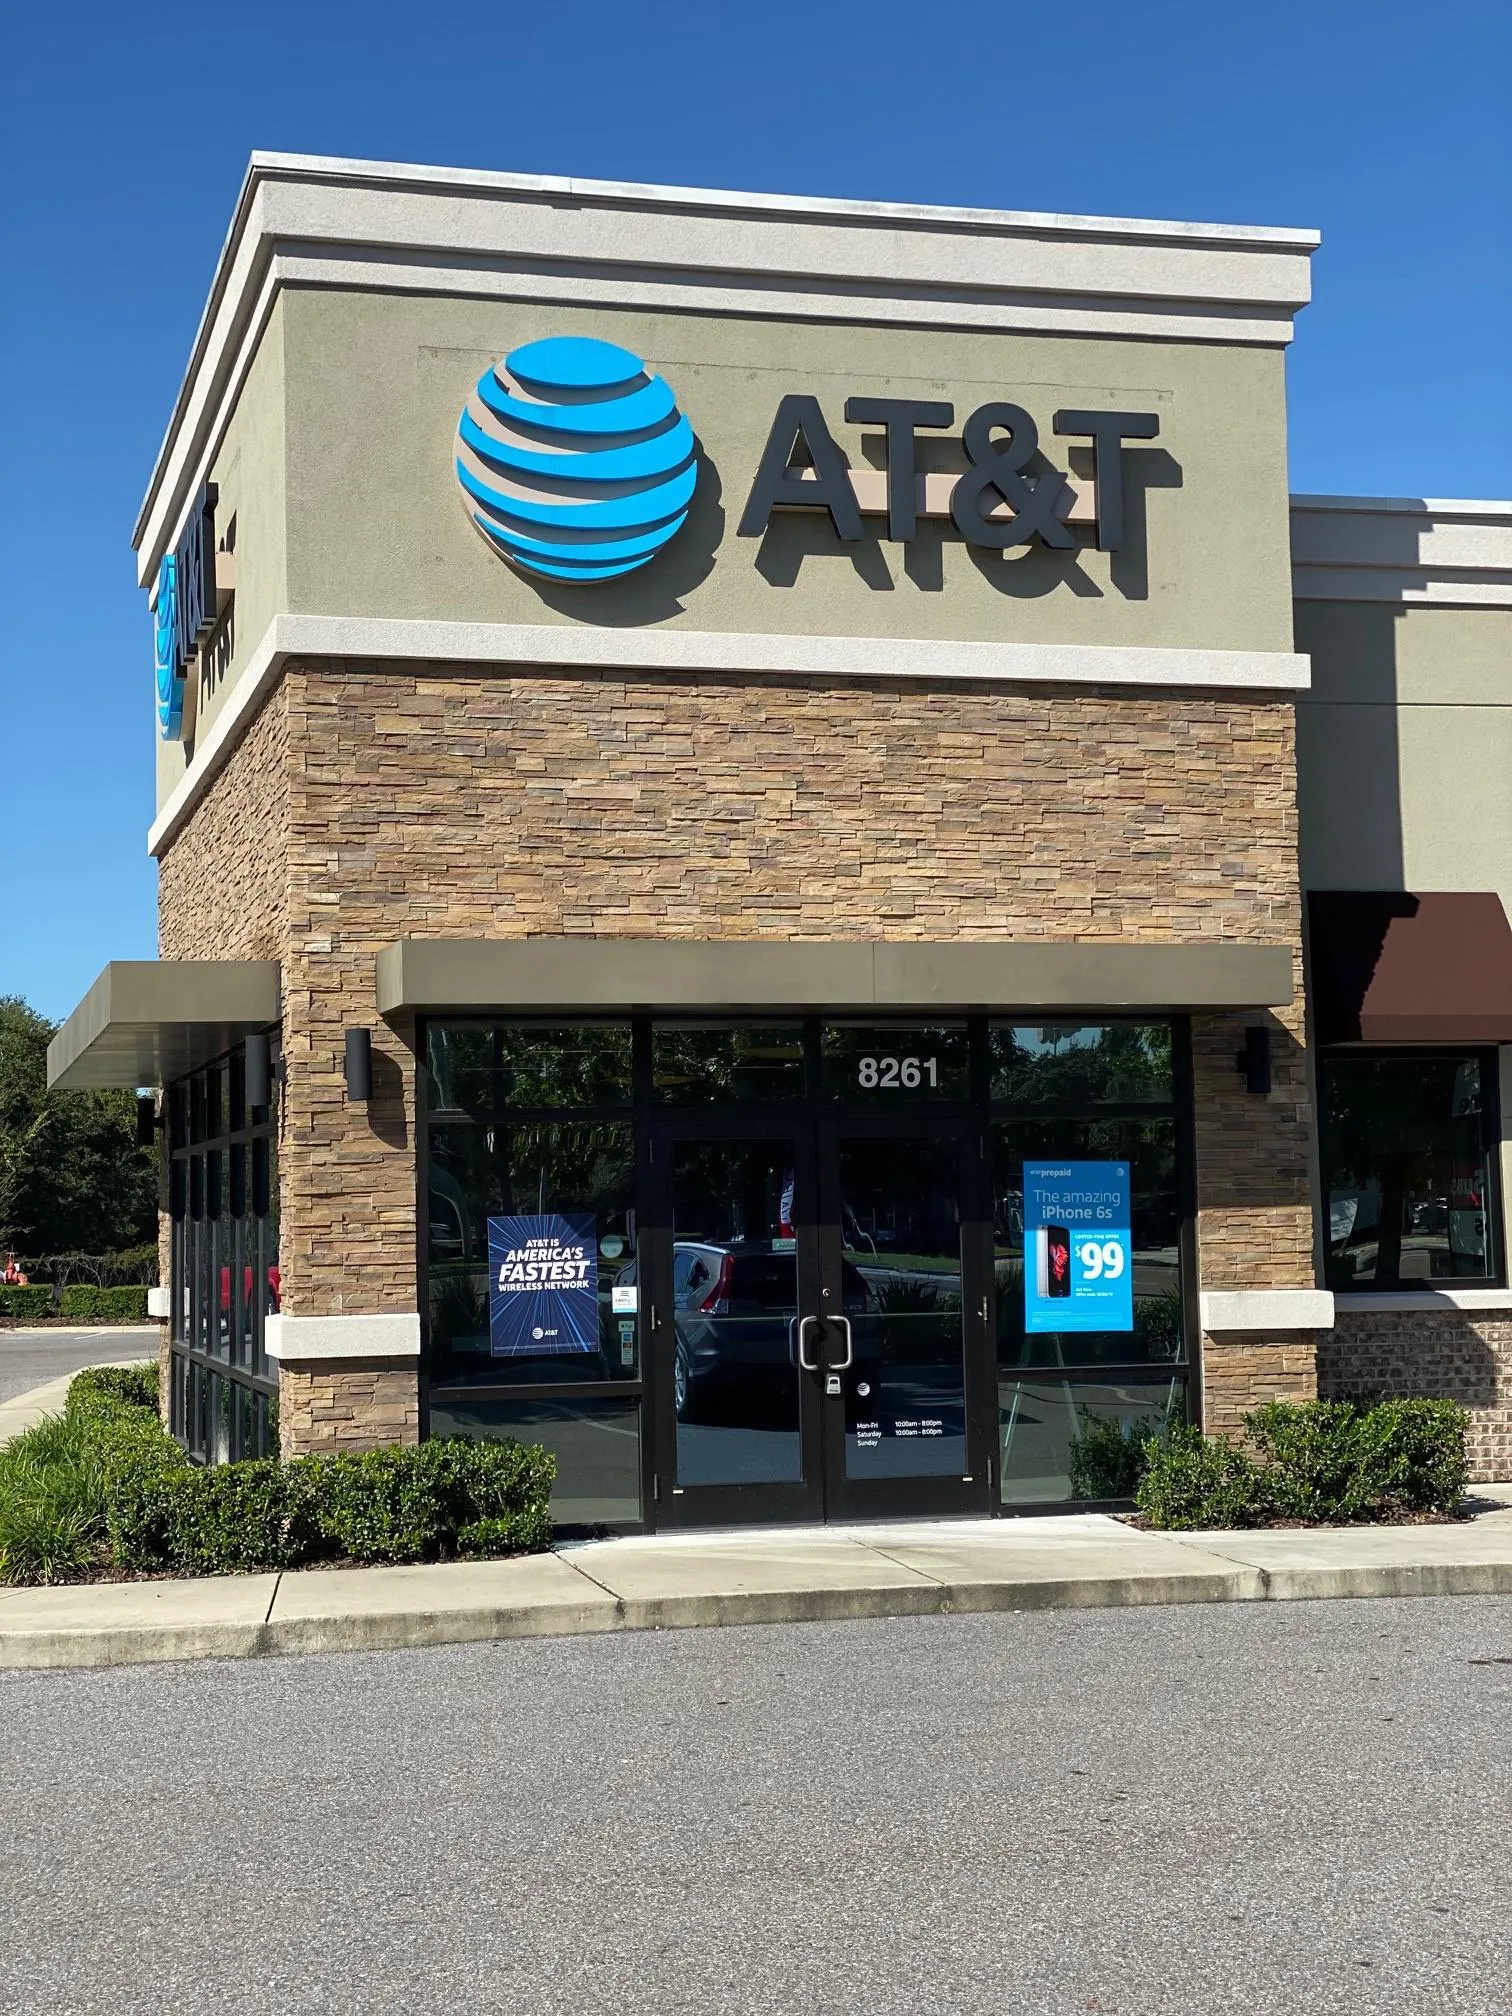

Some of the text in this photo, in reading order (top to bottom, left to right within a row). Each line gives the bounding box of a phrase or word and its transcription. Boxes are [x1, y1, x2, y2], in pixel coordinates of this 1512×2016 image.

[737, 395, 1160, 552] AT&T
[858, 1057, 937, 1088] 8261
[1033, 1189, 1121, 1207] The amazing
[1042, 1205, 1113, 1219] iPhone 6s
[526, 1238, 560, 1248] AT&T IS
[505, 1247, 584, 1262] AMERICA'S
[498, 1260, 591, 1282] FASTEST
[498, 1280, 590, 1292] WIRELESS NETWORK
[857, 1439, 878, 1447] Sunday
